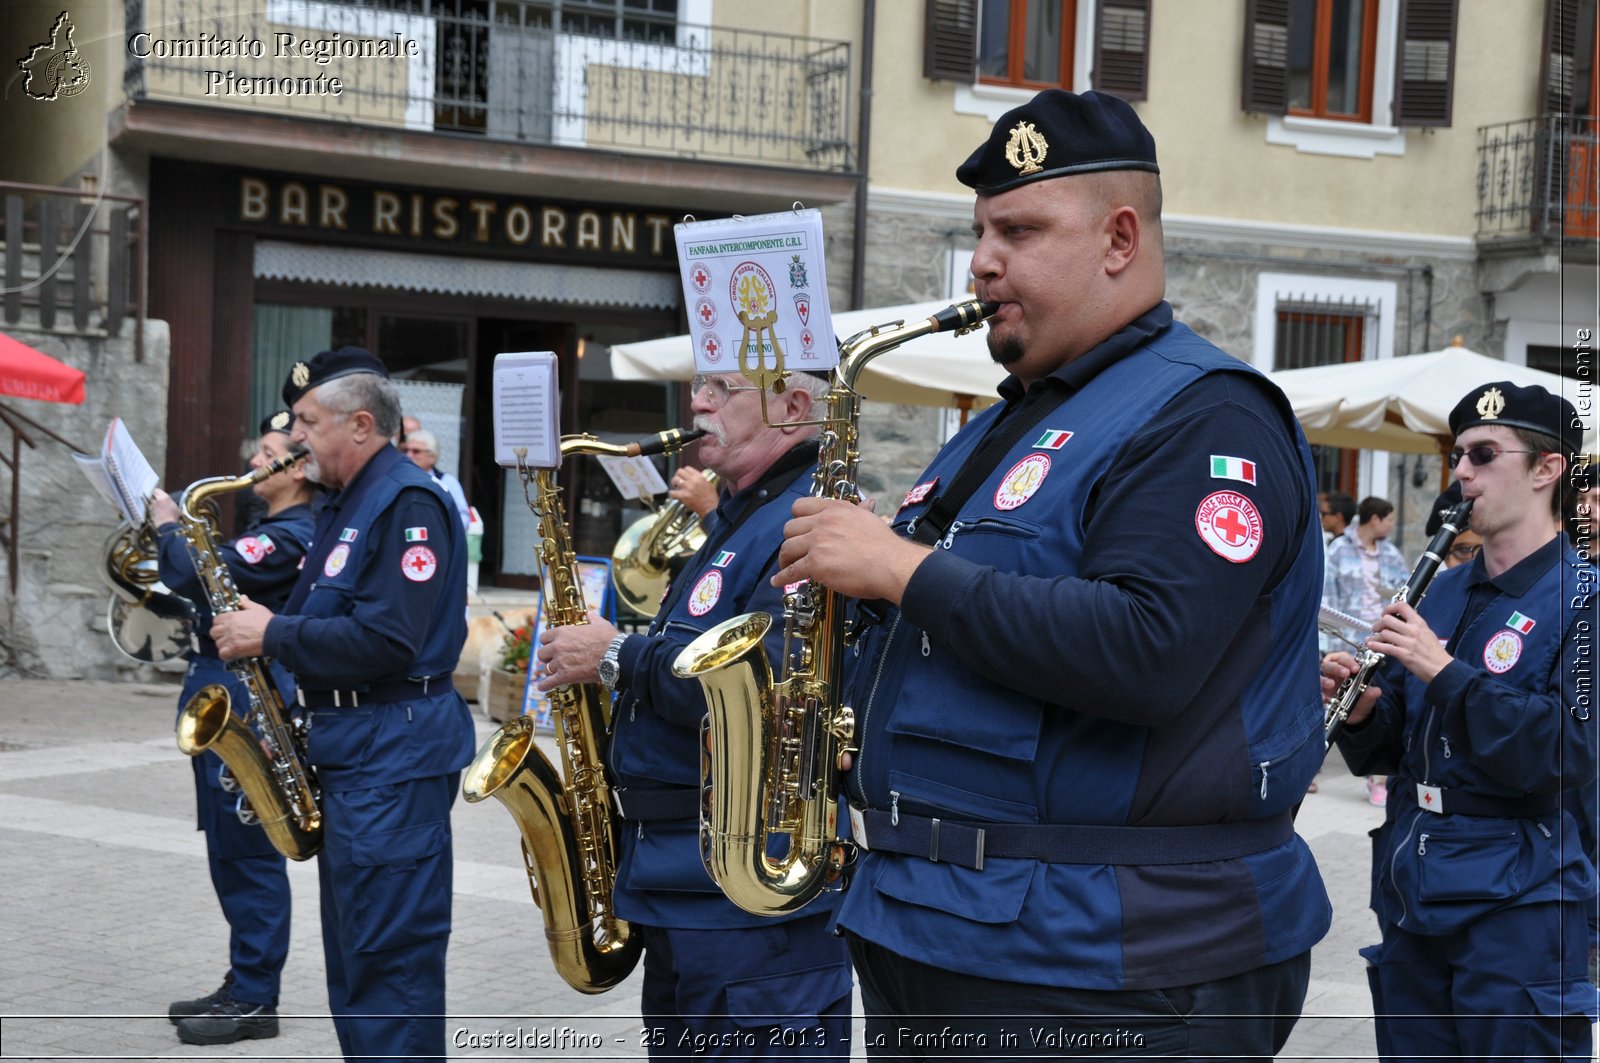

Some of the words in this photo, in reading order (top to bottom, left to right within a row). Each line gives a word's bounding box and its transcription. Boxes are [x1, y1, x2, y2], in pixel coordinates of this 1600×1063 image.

[239, 177, 348, 229] BAR
[689, 243, 719, 255] FANFARA
[719, 238, 785, 253] INTERCOMPONENTE
[738, 265, 754, 276] ROSSA
[756, 268, 774, 299] ITALIANA
[1200, 499, 1218, 524] CROCE
[1215, 495, 1243, 508] ROSSA
[1242, 503, 1259, 541] ITALIANA
